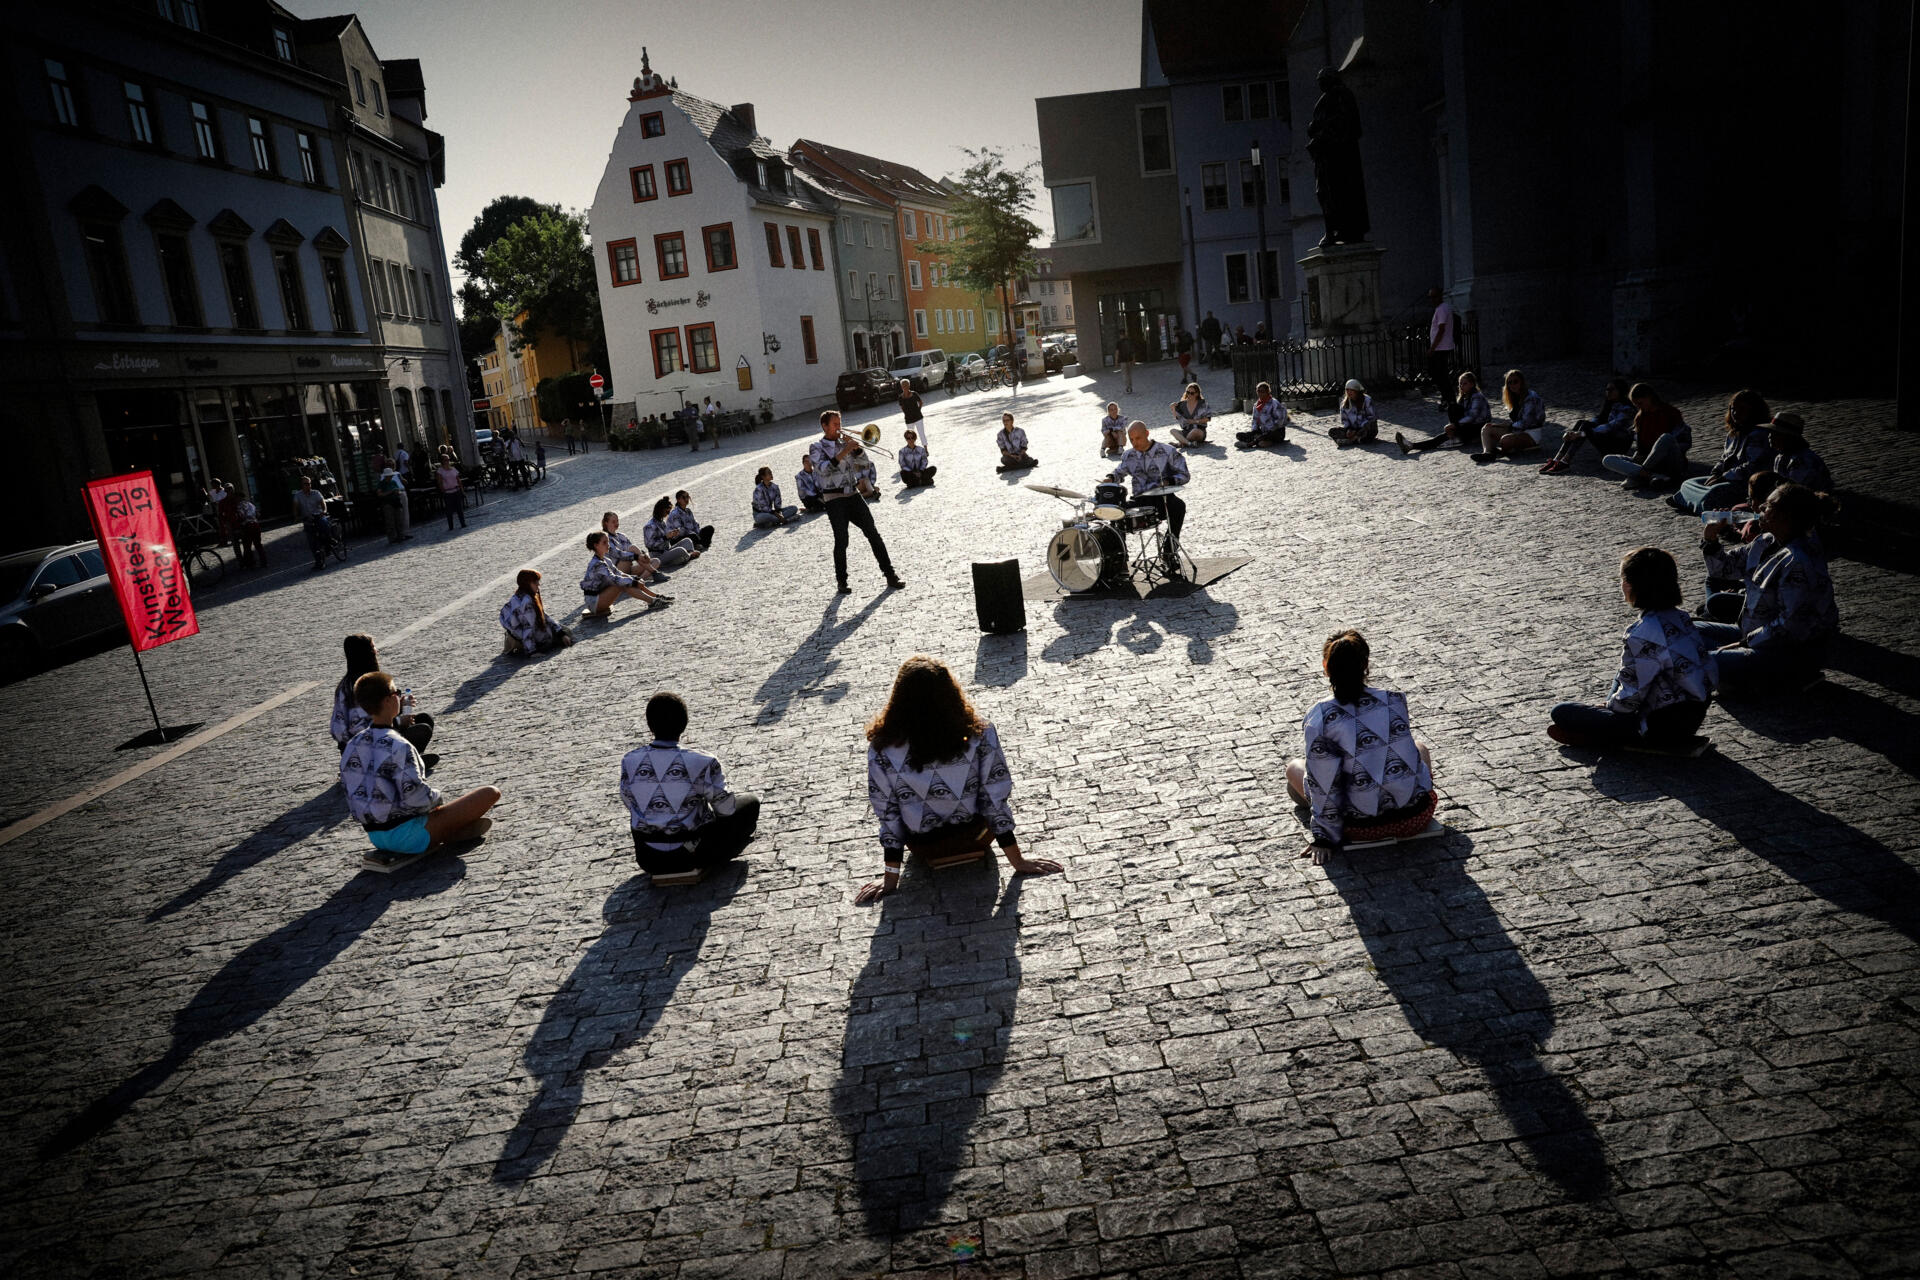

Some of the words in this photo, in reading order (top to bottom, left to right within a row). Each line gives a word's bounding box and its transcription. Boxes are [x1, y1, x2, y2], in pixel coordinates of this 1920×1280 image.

[112, 352, 160, 373] Estragon
[104, 491, 128, 519] 20
[130, 487, 153, 512] 19
[118, 531, 166, 640] Kunstfest
[154, 546, 188, 634] Weimar
